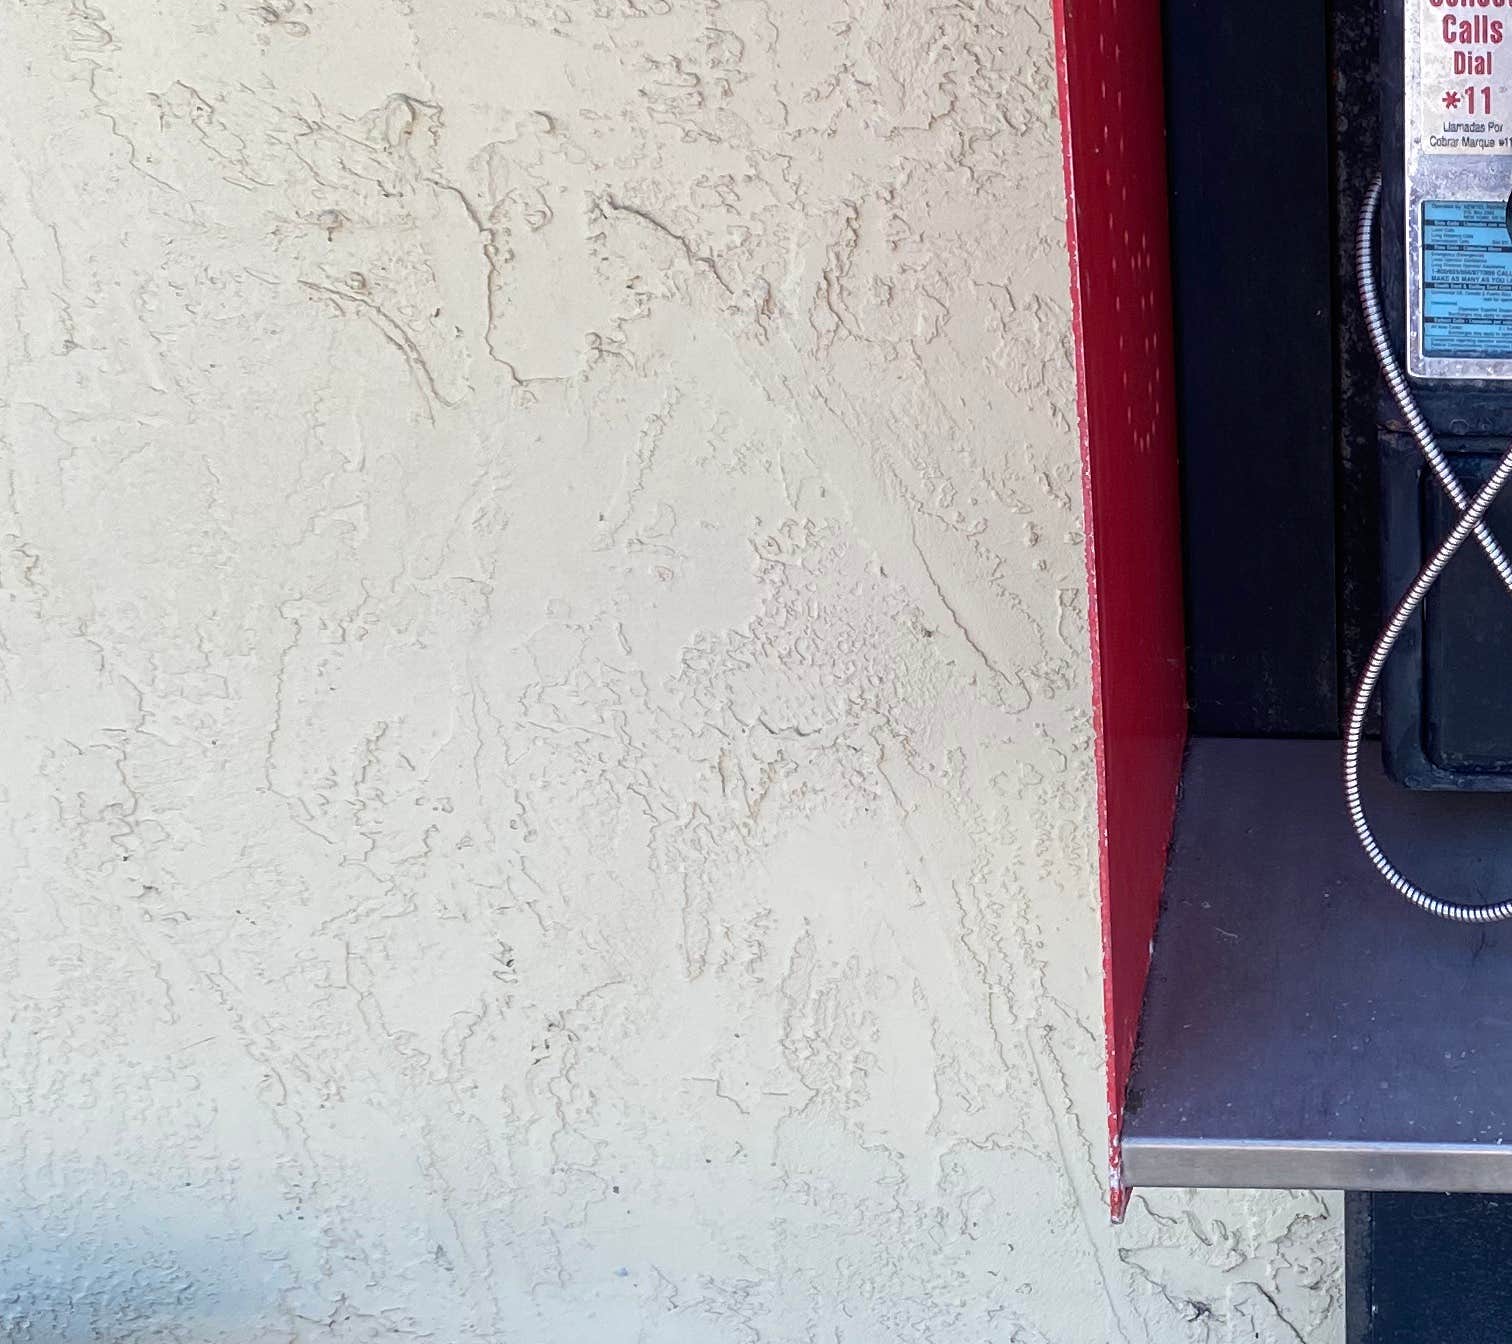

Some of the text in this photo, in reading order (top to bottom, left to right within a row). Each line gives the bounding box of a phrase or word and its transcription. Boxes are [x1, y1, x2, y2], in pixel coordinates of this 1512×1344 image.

[1442, 13, 1504, 45] Calls
[1453, 50, 1493, 75] Dial
[1443, 121, 1504, 133] Llamadas Por
[1429, 135, 1460, 148] Cobrar
[1461, 136, 1496, 152] Marque
